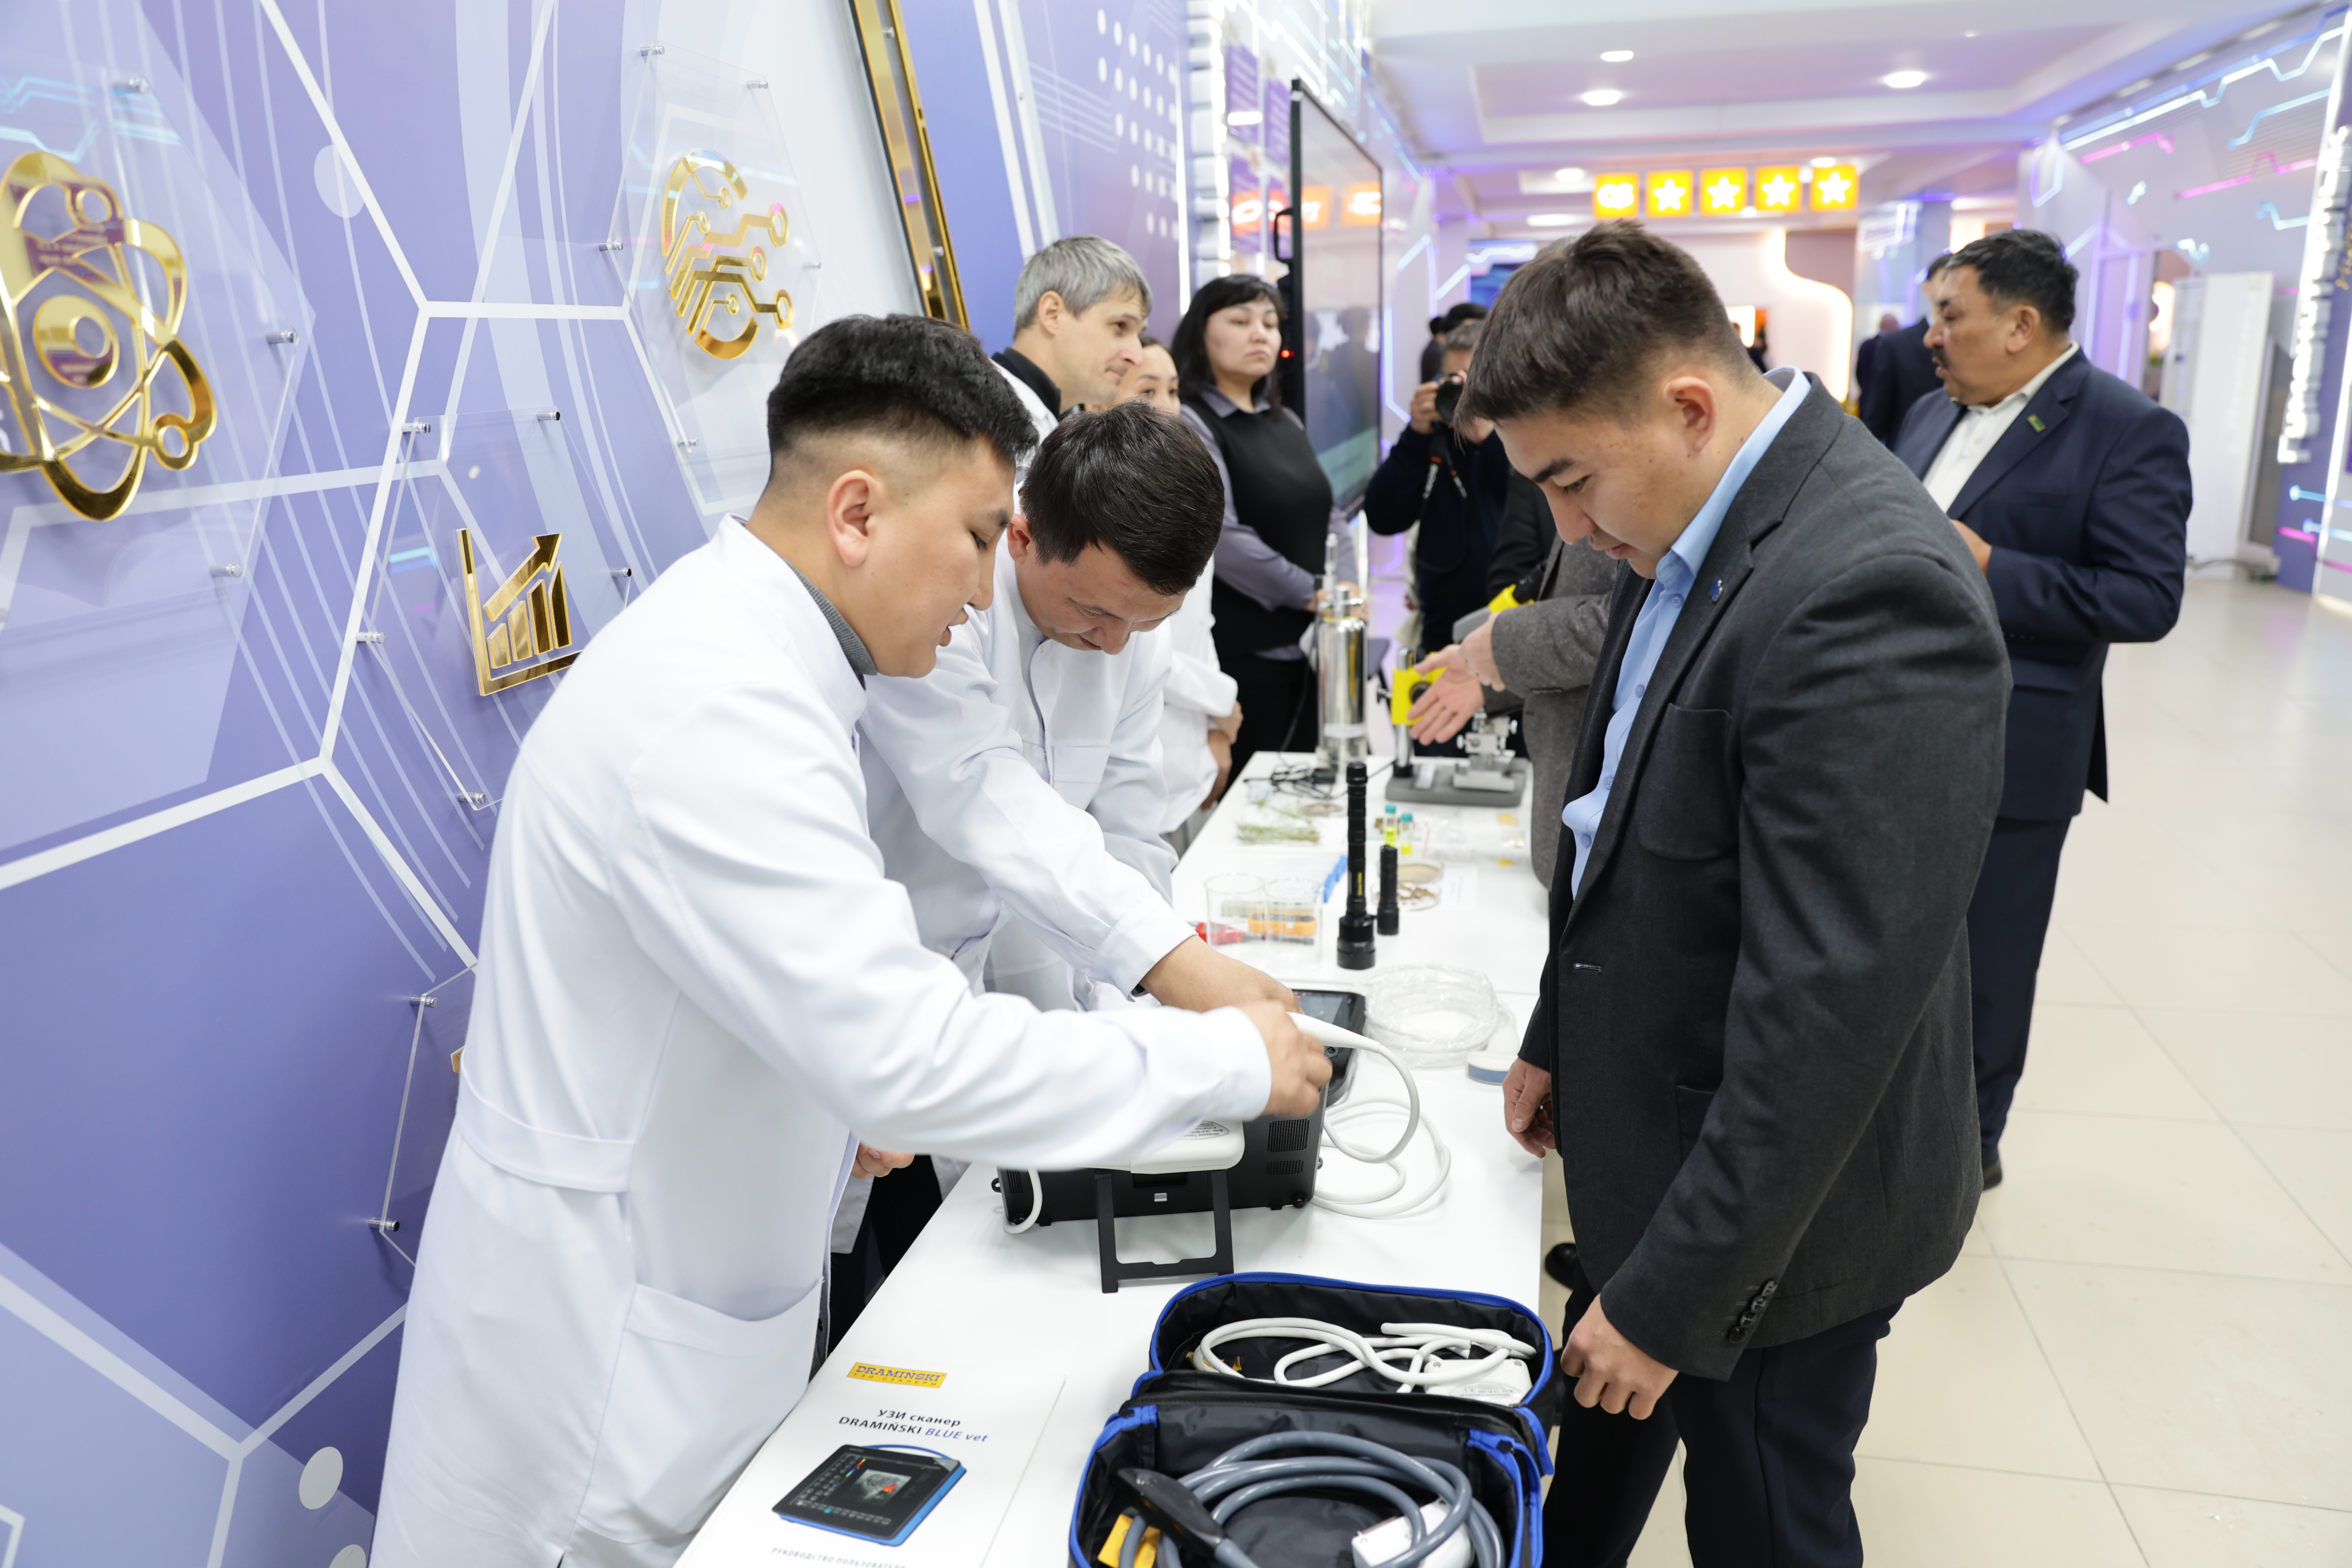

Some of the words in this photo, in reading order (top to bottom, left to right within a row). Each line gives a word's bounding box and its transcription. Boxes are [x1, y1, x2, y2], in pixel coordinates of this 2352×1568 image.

[882, 1377, 937, 1386] СКАНЕРЫ
[877, 1409, 907, 1419] УЗИ
[909, 1414, 960, 1427] сканер
[838, 1416, 923, 1434] DRAMIŃSKI
[924, 1428, 963, 1439] BLUE
[965, 1434, 989, 1442] vet
[771, 1547, 835, 1563] РУКОВОДСТВО
